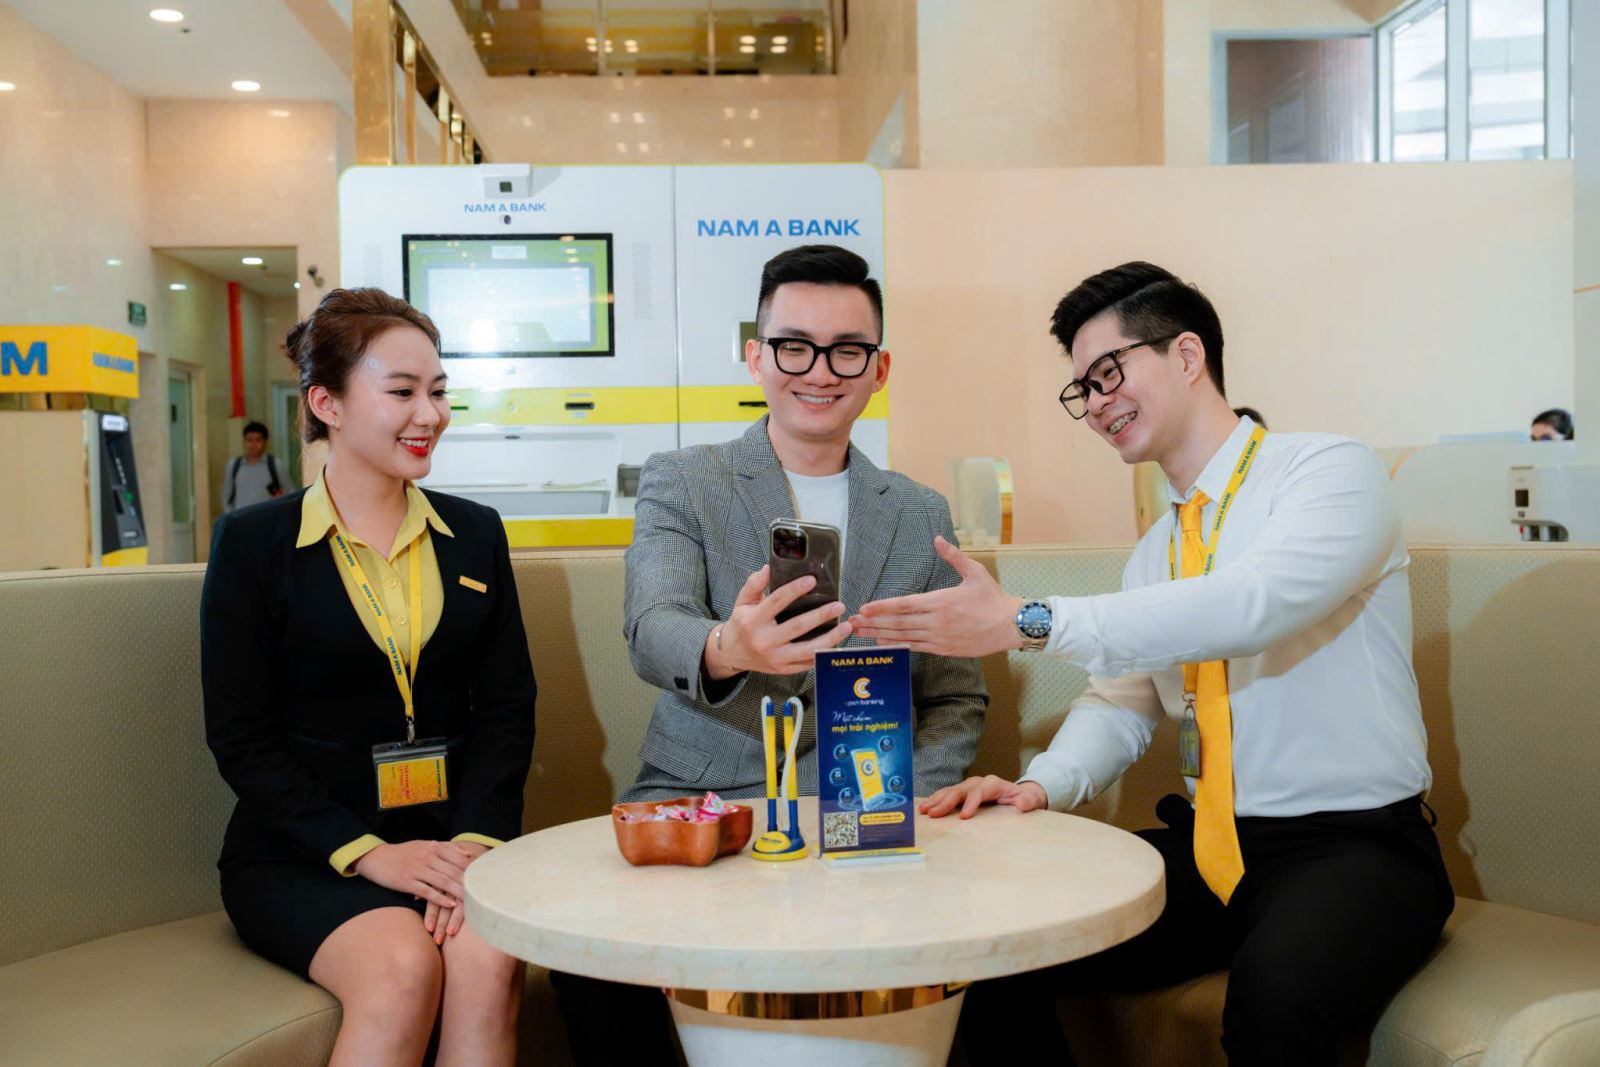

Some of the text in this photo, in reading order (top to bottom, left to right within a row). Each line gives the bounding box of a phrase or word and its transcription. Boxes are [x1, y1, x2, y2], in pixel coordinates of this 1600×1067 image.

[464, 203, 545, 213] NAM A BANK
[697, 219, 861, 237] NAM A BANK
[1, 341, 48, 376] M
[1246, 439, 1257, 456] BANK
[346, 553, 356, 567] NAM
[394, 659, 402, 675] NAM
[831, 658, 856, 667] NAM
[866, 656, 894, 665] BANK
